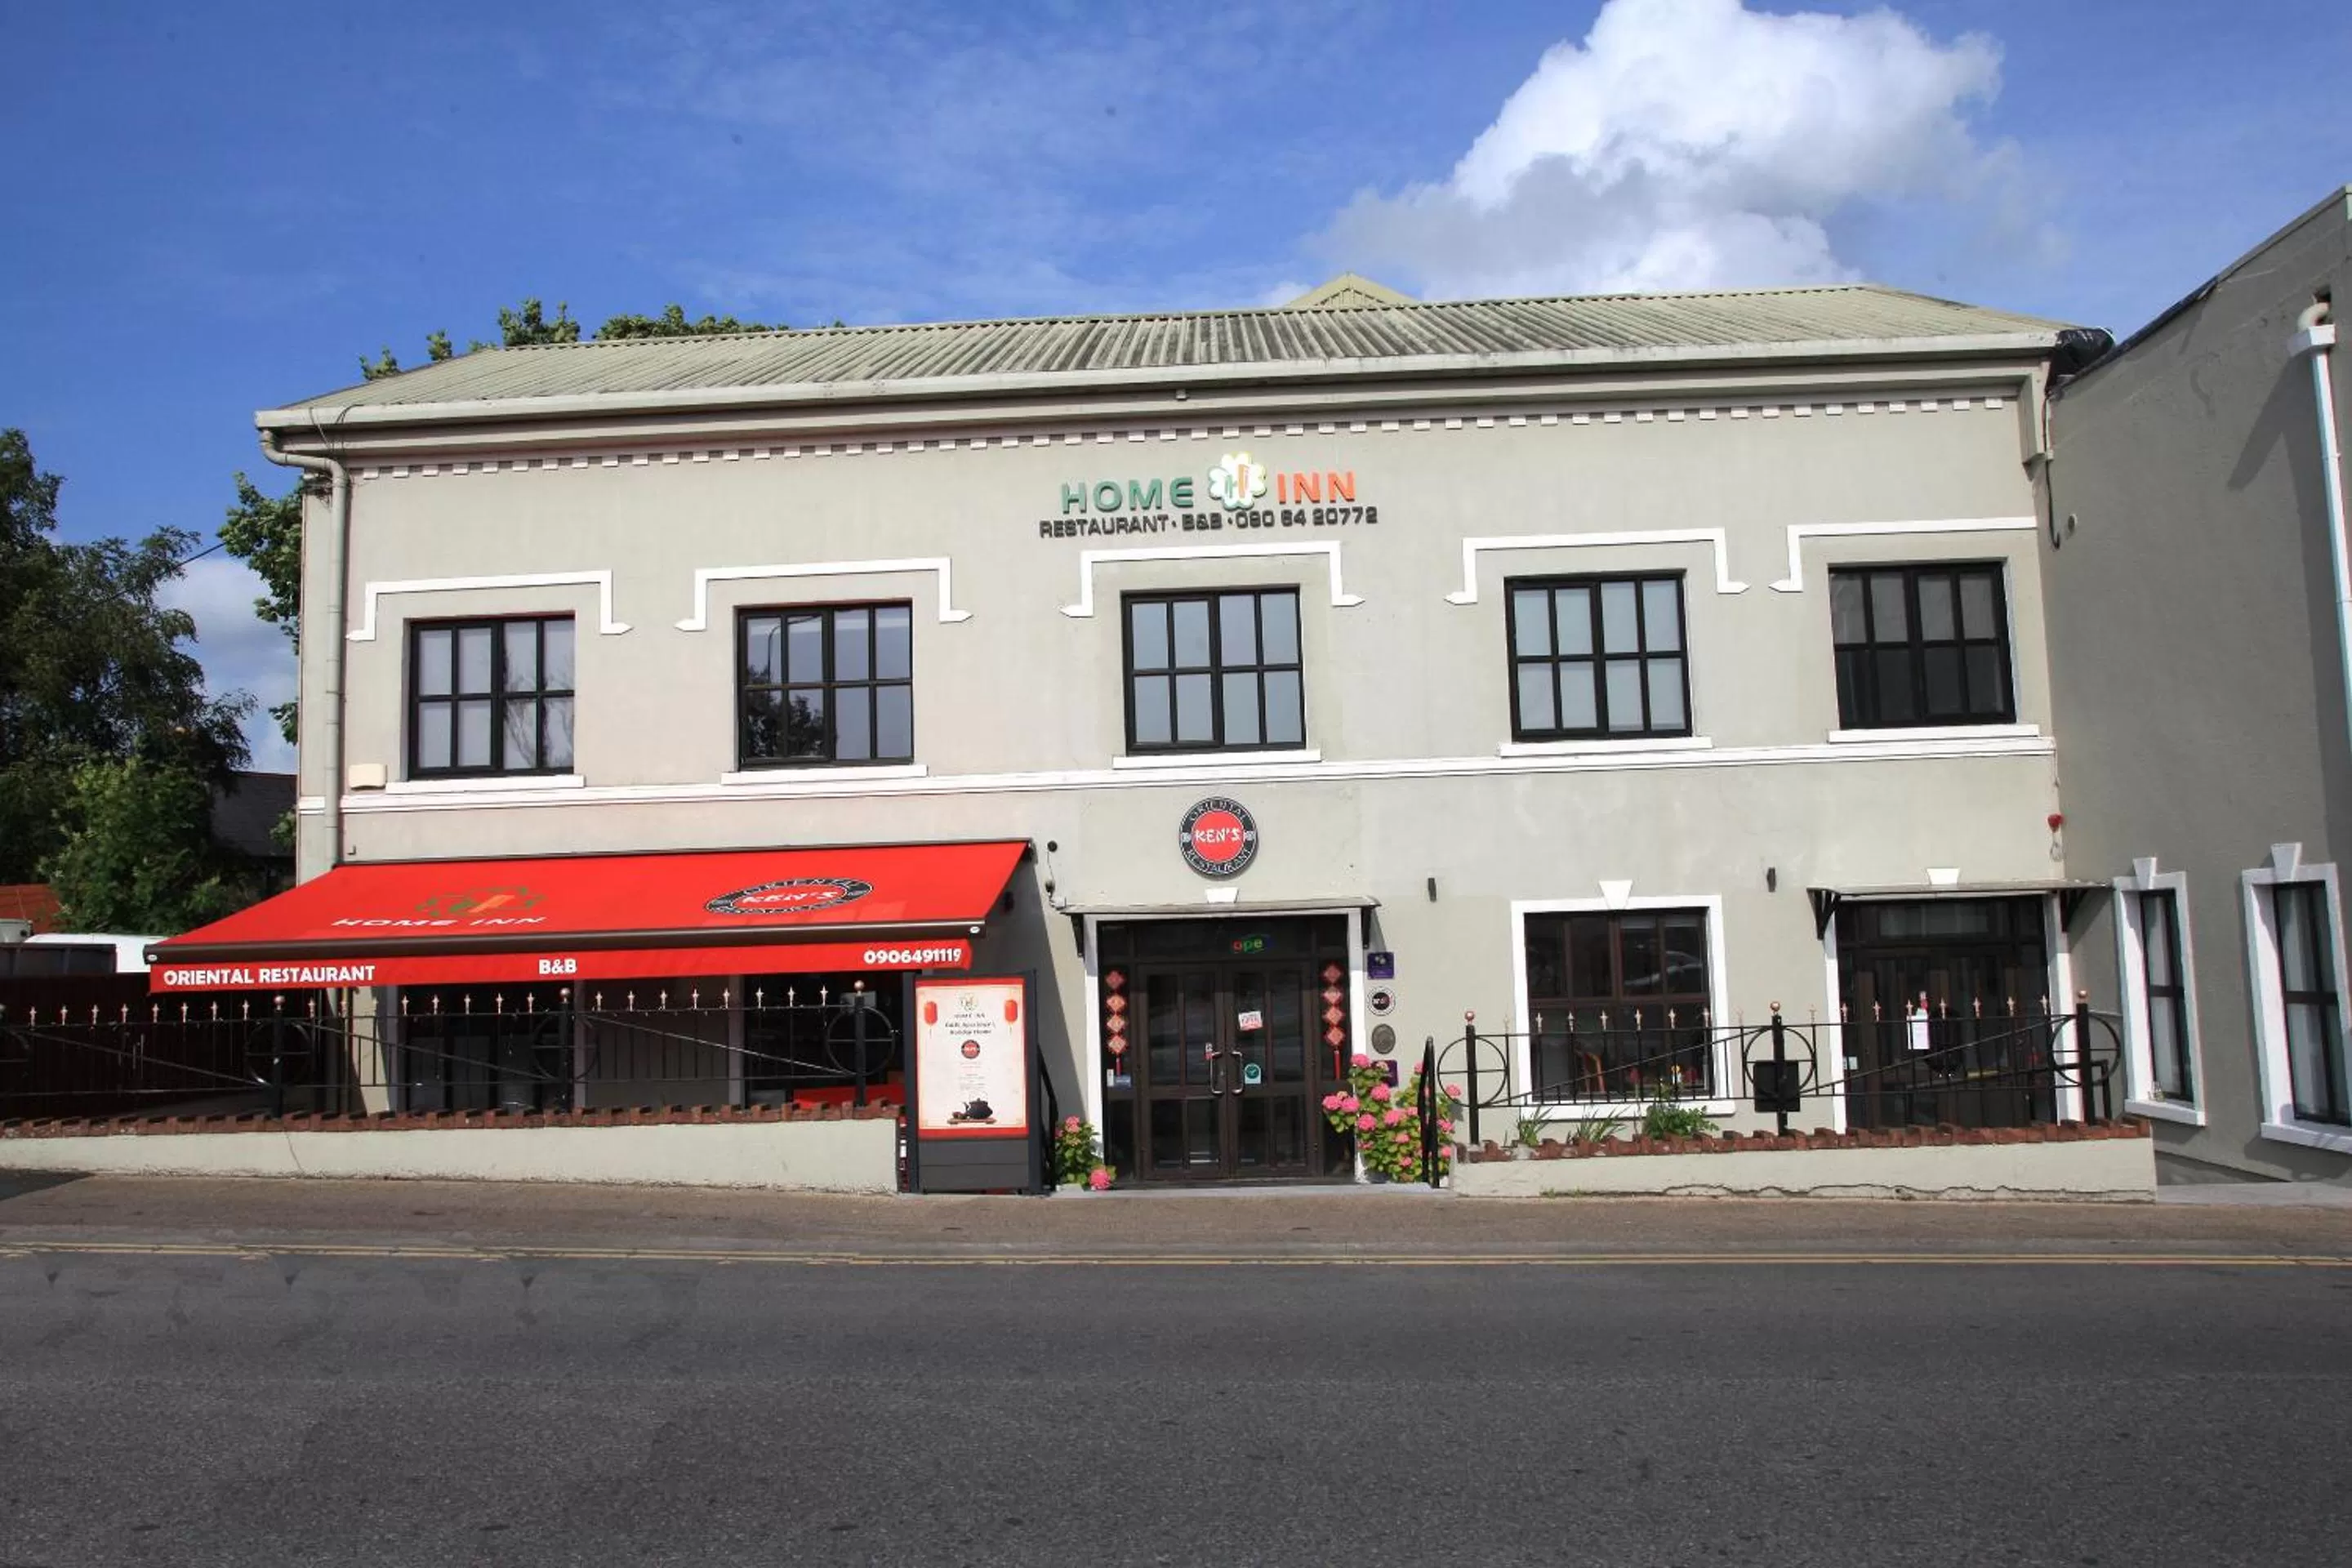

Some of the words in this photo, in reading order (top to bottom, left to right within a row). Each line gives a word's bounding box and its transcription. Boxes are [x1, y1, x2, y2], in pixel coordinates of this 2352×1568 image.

[1062, 476, 1195, 514] HOME
[1276, 470, 1356, 505] INN
[1039, 514, 1169, 538] RESTAURANT
[1182, 513, 1223, 532] B&B
[1281, 508, 1307, 527] 64
[1312, 506, 1379, 526] 20772
[1195, 826, 1241, 843] KEN'S
[332, 917, 458, 926] HOME
[470, 916, 546, 926] INN
[863, 948, 962, 964] 0906491119
[539, 958, 577, 974] B&B
[163, 969, 255, 986] ORIENTAL
[258, 965, 376, 984] RESTAURANT
